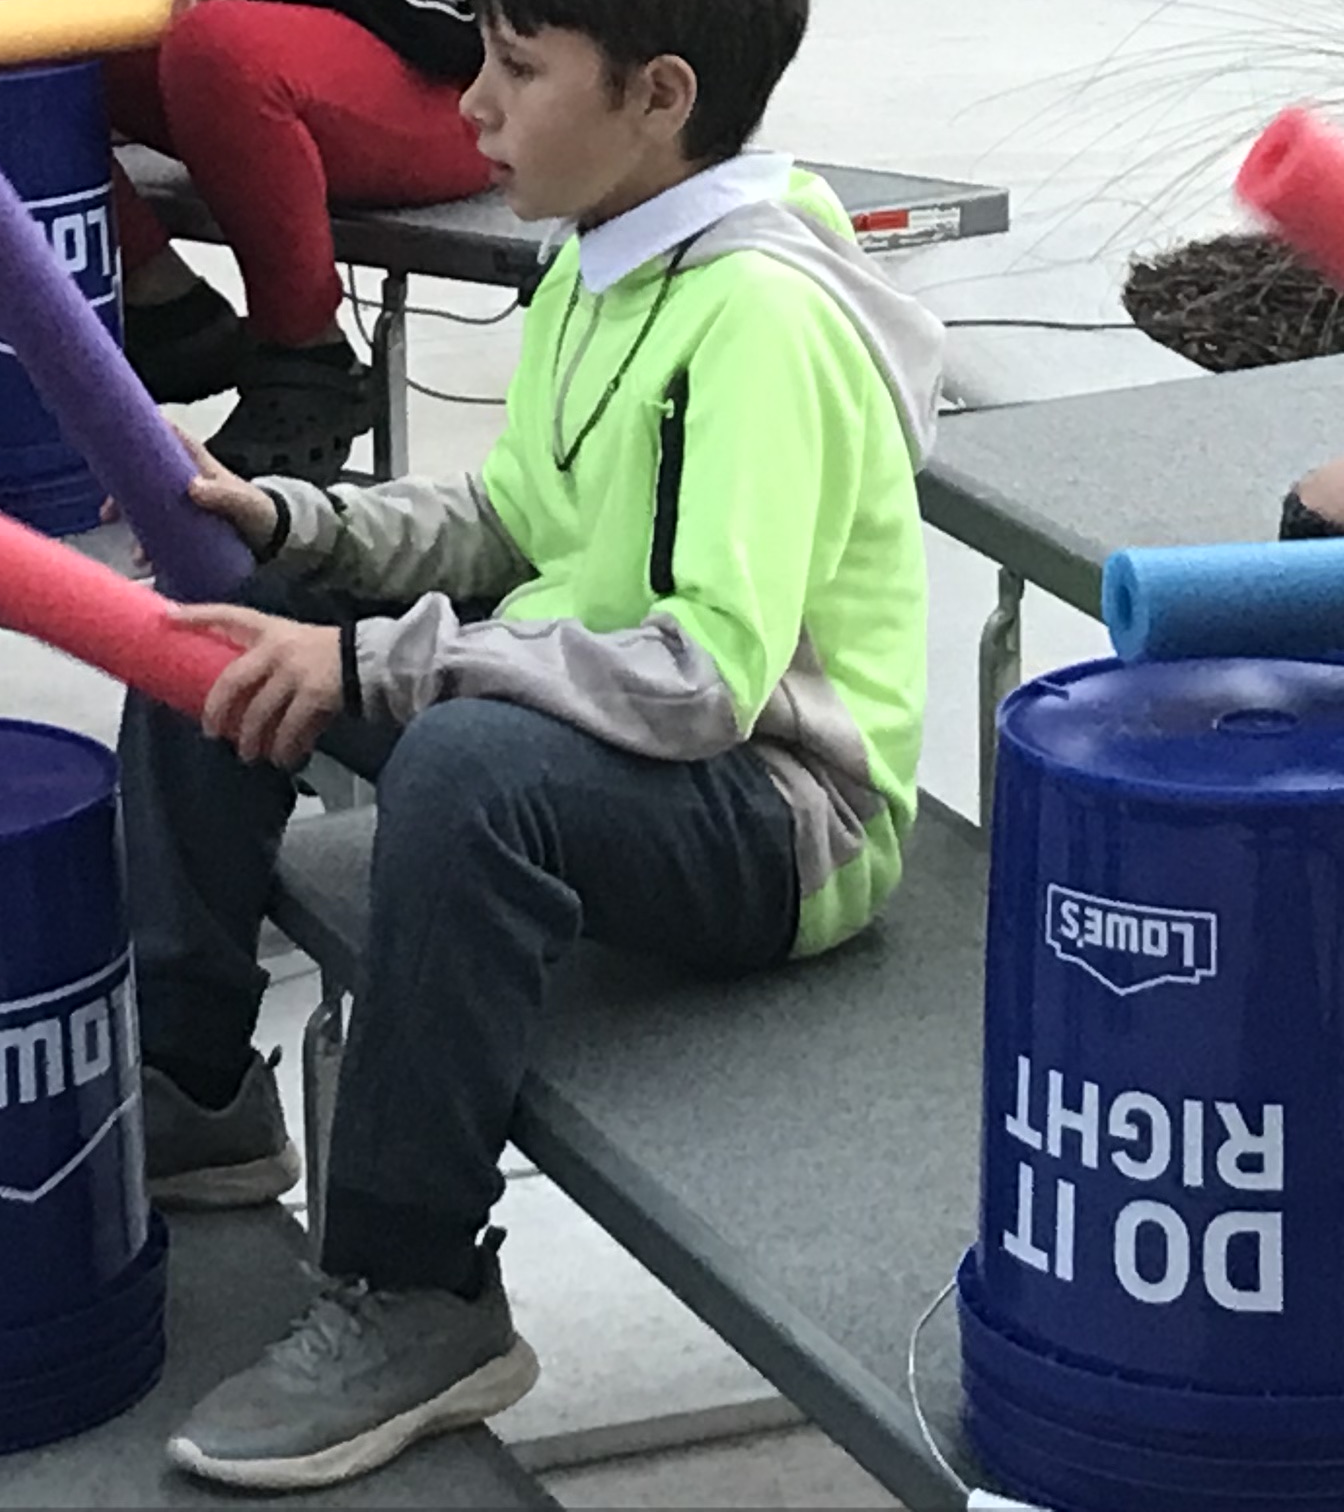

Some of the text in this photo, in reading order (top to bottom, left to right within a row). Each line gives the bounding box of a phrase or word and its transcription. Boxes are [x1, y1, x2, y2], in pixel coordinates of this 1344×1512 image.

[1060, 899, 1195, 968] LOWE'S
[1004, 1054, 1284, 1192] RIGHT
[1002, 1162, 1284, 1313] DO IT
